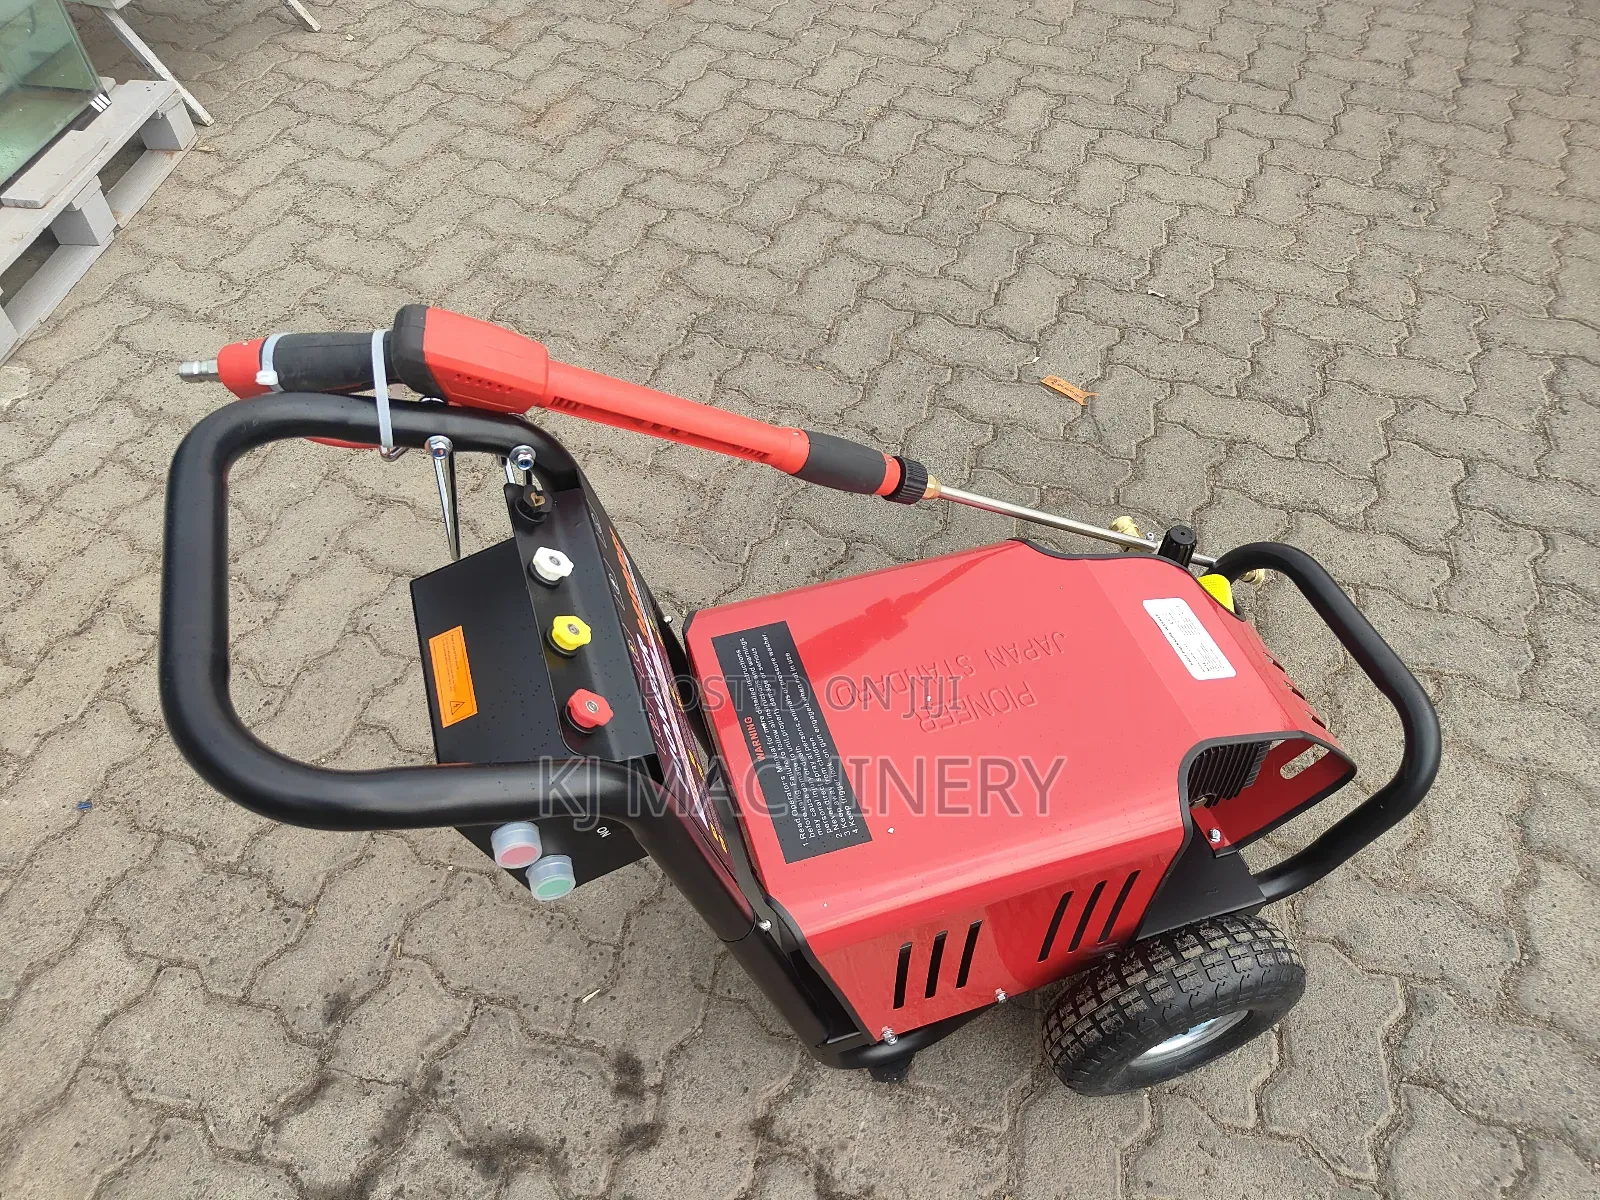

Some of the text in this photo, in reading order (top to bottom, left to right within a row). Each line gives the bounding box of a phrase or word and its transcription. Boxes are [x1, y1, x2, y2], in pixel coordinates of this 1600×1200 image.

[739, 637, 754, 666] warnings
[761, 632, 774, 656] washer.
[785, 651, 793, 664] use.
[736, 649, 752, 686] instructions
[751, 647, 763, 671] serious
[771, 657, 786, 685] pressure
[836, 630, 1067, 707] JAPAN STANDARD
[748, 687, 762, 714] detailed
[754, 680, 772, 719] instructions
[763, 679, 777, 706] damage
[797, 683, 808, 702] when
[803, 703, 820, 733] engaged
[919, 680, 1039, 734] PIONEER
[744, 716, 766, 761] WARNING
[772, 729, 784, 750] follow
[809, 735, 824, 766] children.
[768, 745, 783, 772] Manual
[795, 743, 807, 767] death.
[783, 759, 797, 786] Failure
[793, 762, 808, 792] damage
[809, 761, 822, 781] spray
[820, 767, 831, 784] from
[780, 775, 798, 816] Operator's
[806, 776, 819, 798] injury
[817, 783, 830, 805] direct
[828, 786, 840, 805] away
[834, 779, 848, 803] trigger
[804, 793, 817, 817] cause
[814, 799, 833, 834] personal
[802, 812, 815, 838] before
